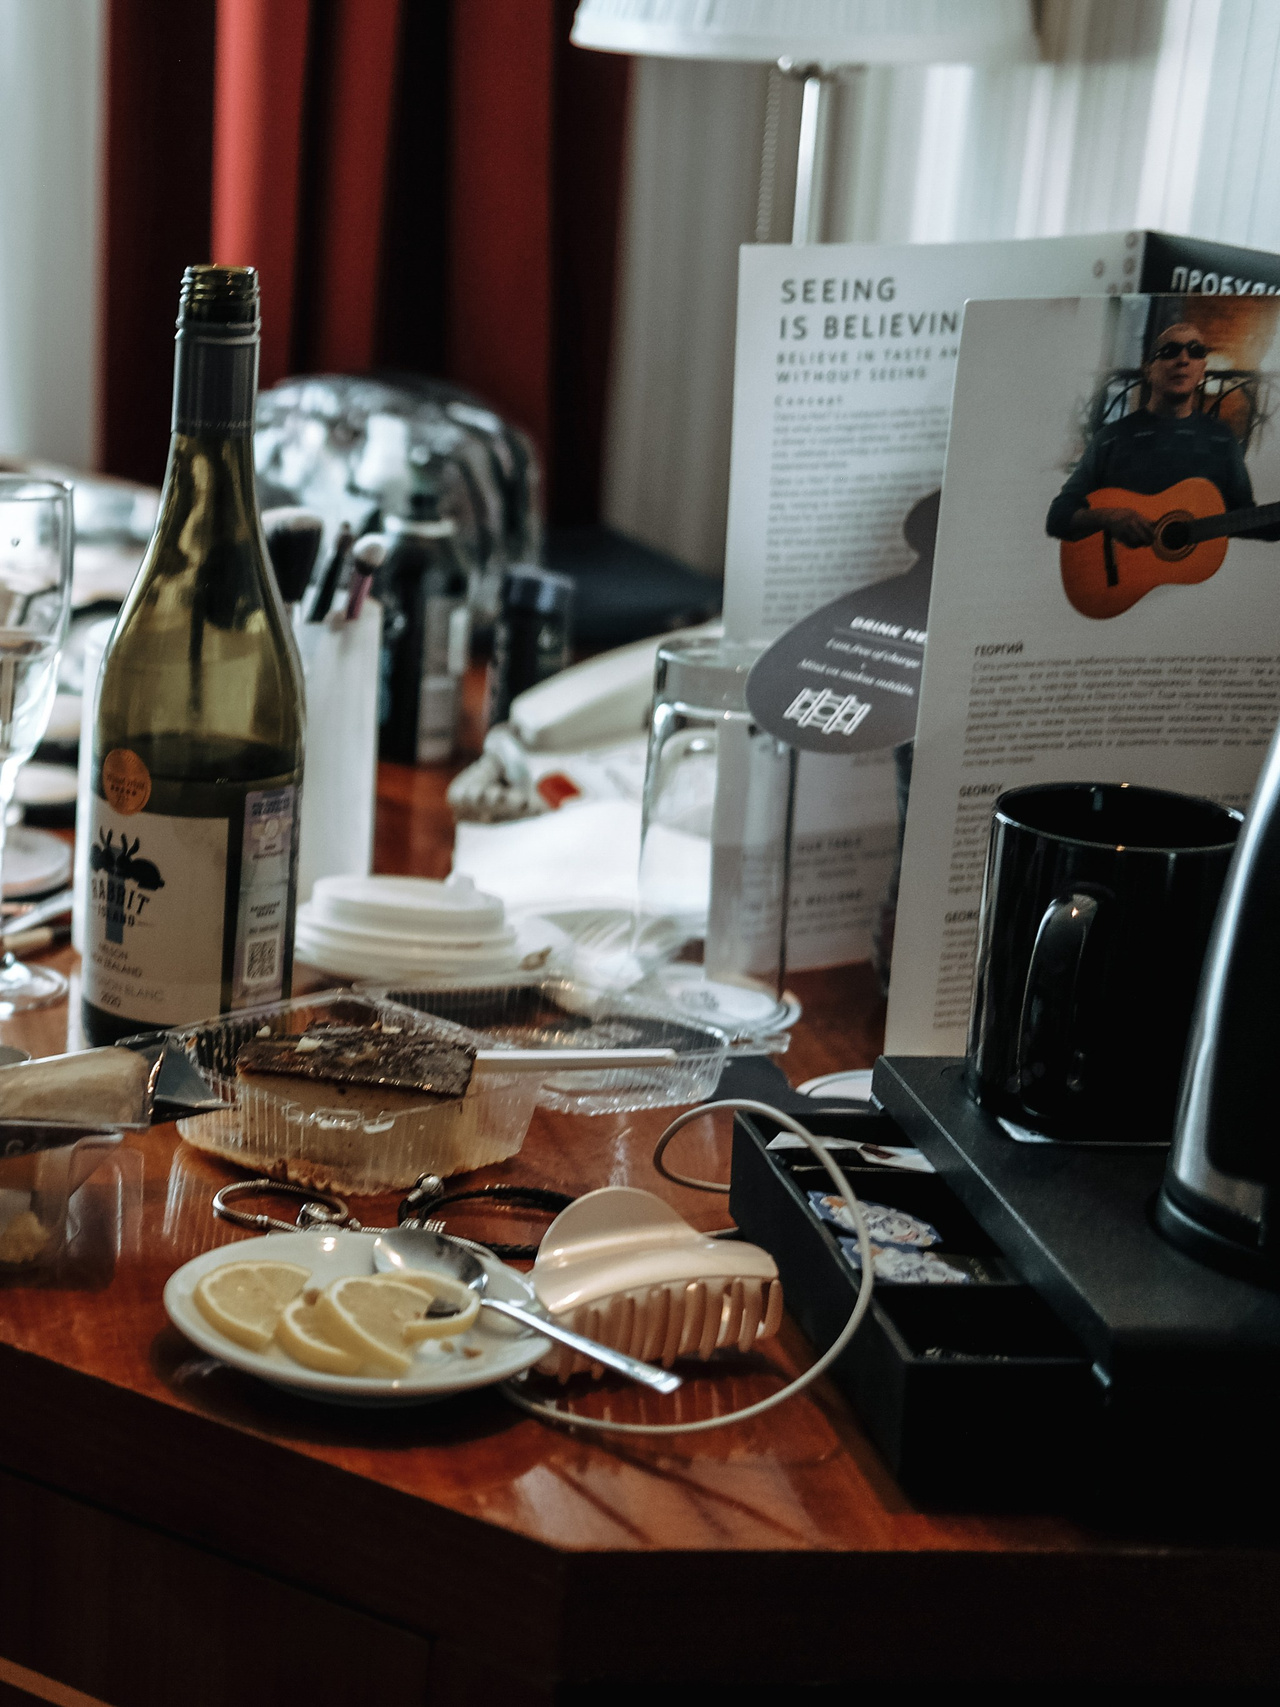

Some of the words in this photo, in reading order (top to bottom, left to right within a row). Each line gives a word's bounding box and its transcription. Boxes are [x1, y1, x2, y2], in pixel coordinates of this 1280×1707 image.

[780, 276, 895, 304] SEEING
[779, 314, 807, 341] IS
[823, 310, 958, 340] BELIEVIN
[776, 351, 848, 365] BELIEVE
[856, 350, 874, 362] IN
[883, 347, 932, 361] TASTE
[776, 367, 860, 383] WITHOUT
[871, 365, 927, 382] SEEING
[850, 616, 903, 638] DRINK
[974, 640, 1024, 657] ГЕОРГИЙ
[959, 783, 1004, 798] GEORGY
[91, 877, 151, 916] RABBIT
